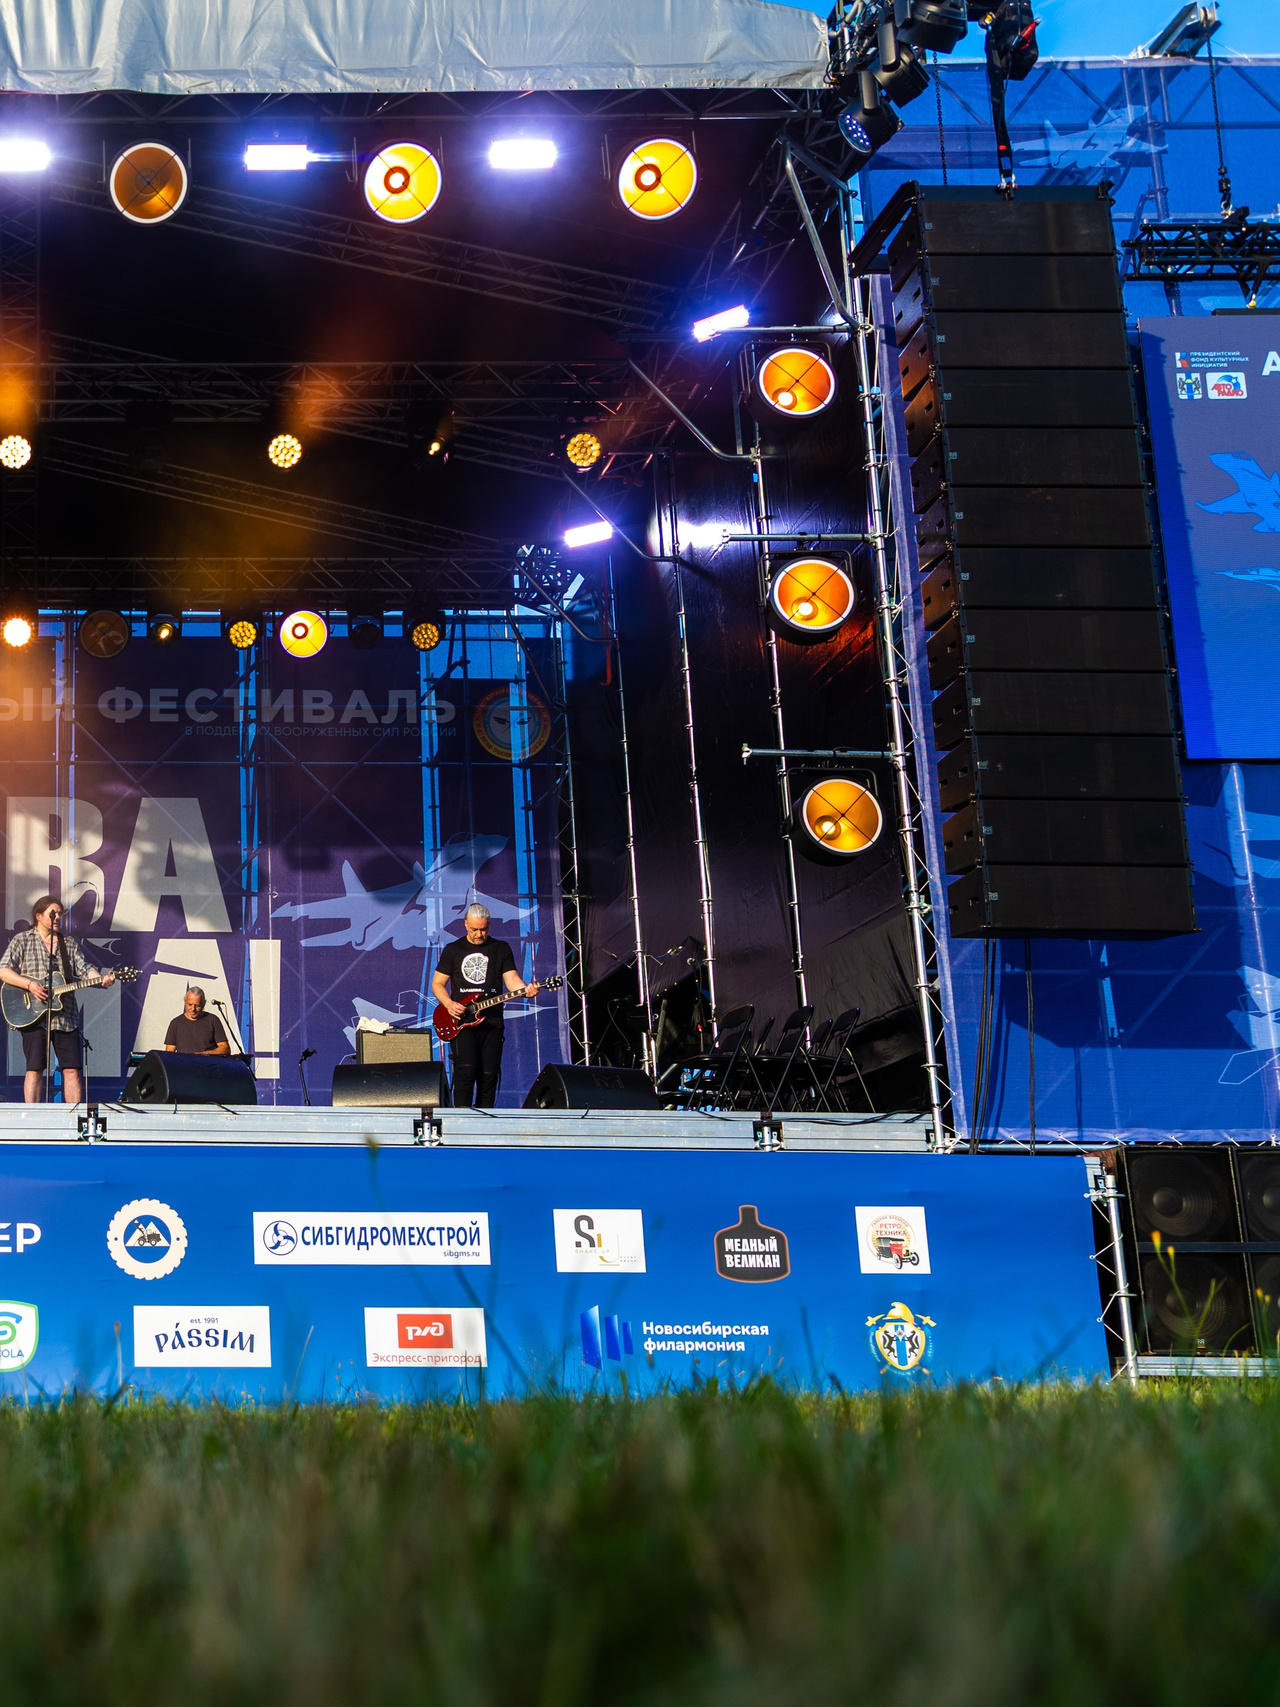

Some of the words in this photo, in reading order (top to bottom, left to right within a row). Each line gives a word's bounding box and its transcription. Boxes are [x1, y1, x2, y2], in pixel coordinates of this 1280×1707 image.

[97, 686, 456, 725] ФЕСТИВАЛЬ
[274, 727, 369, 738] ВООРУЖЕННЫХ
[372, 728, 400, 737] СИЛ
[301, 1220, 481, 1251] СИБГИДРОМЕХСТРОЙ
[724, 1236, 778, 1252] МЕДНЫЙ
[443, 1249, 481, 1258] sibgms.ru
[724, 1254, 781, 1268] ВЕЛИКАН
[154, 1322, 255, 1353] PÁSSIM
[642, 1321, 769, 1338] Новосибирская
[643, 1337, 746, 1354] филармония
[372, 1352, 481, 1365] Экспресс-пригород
